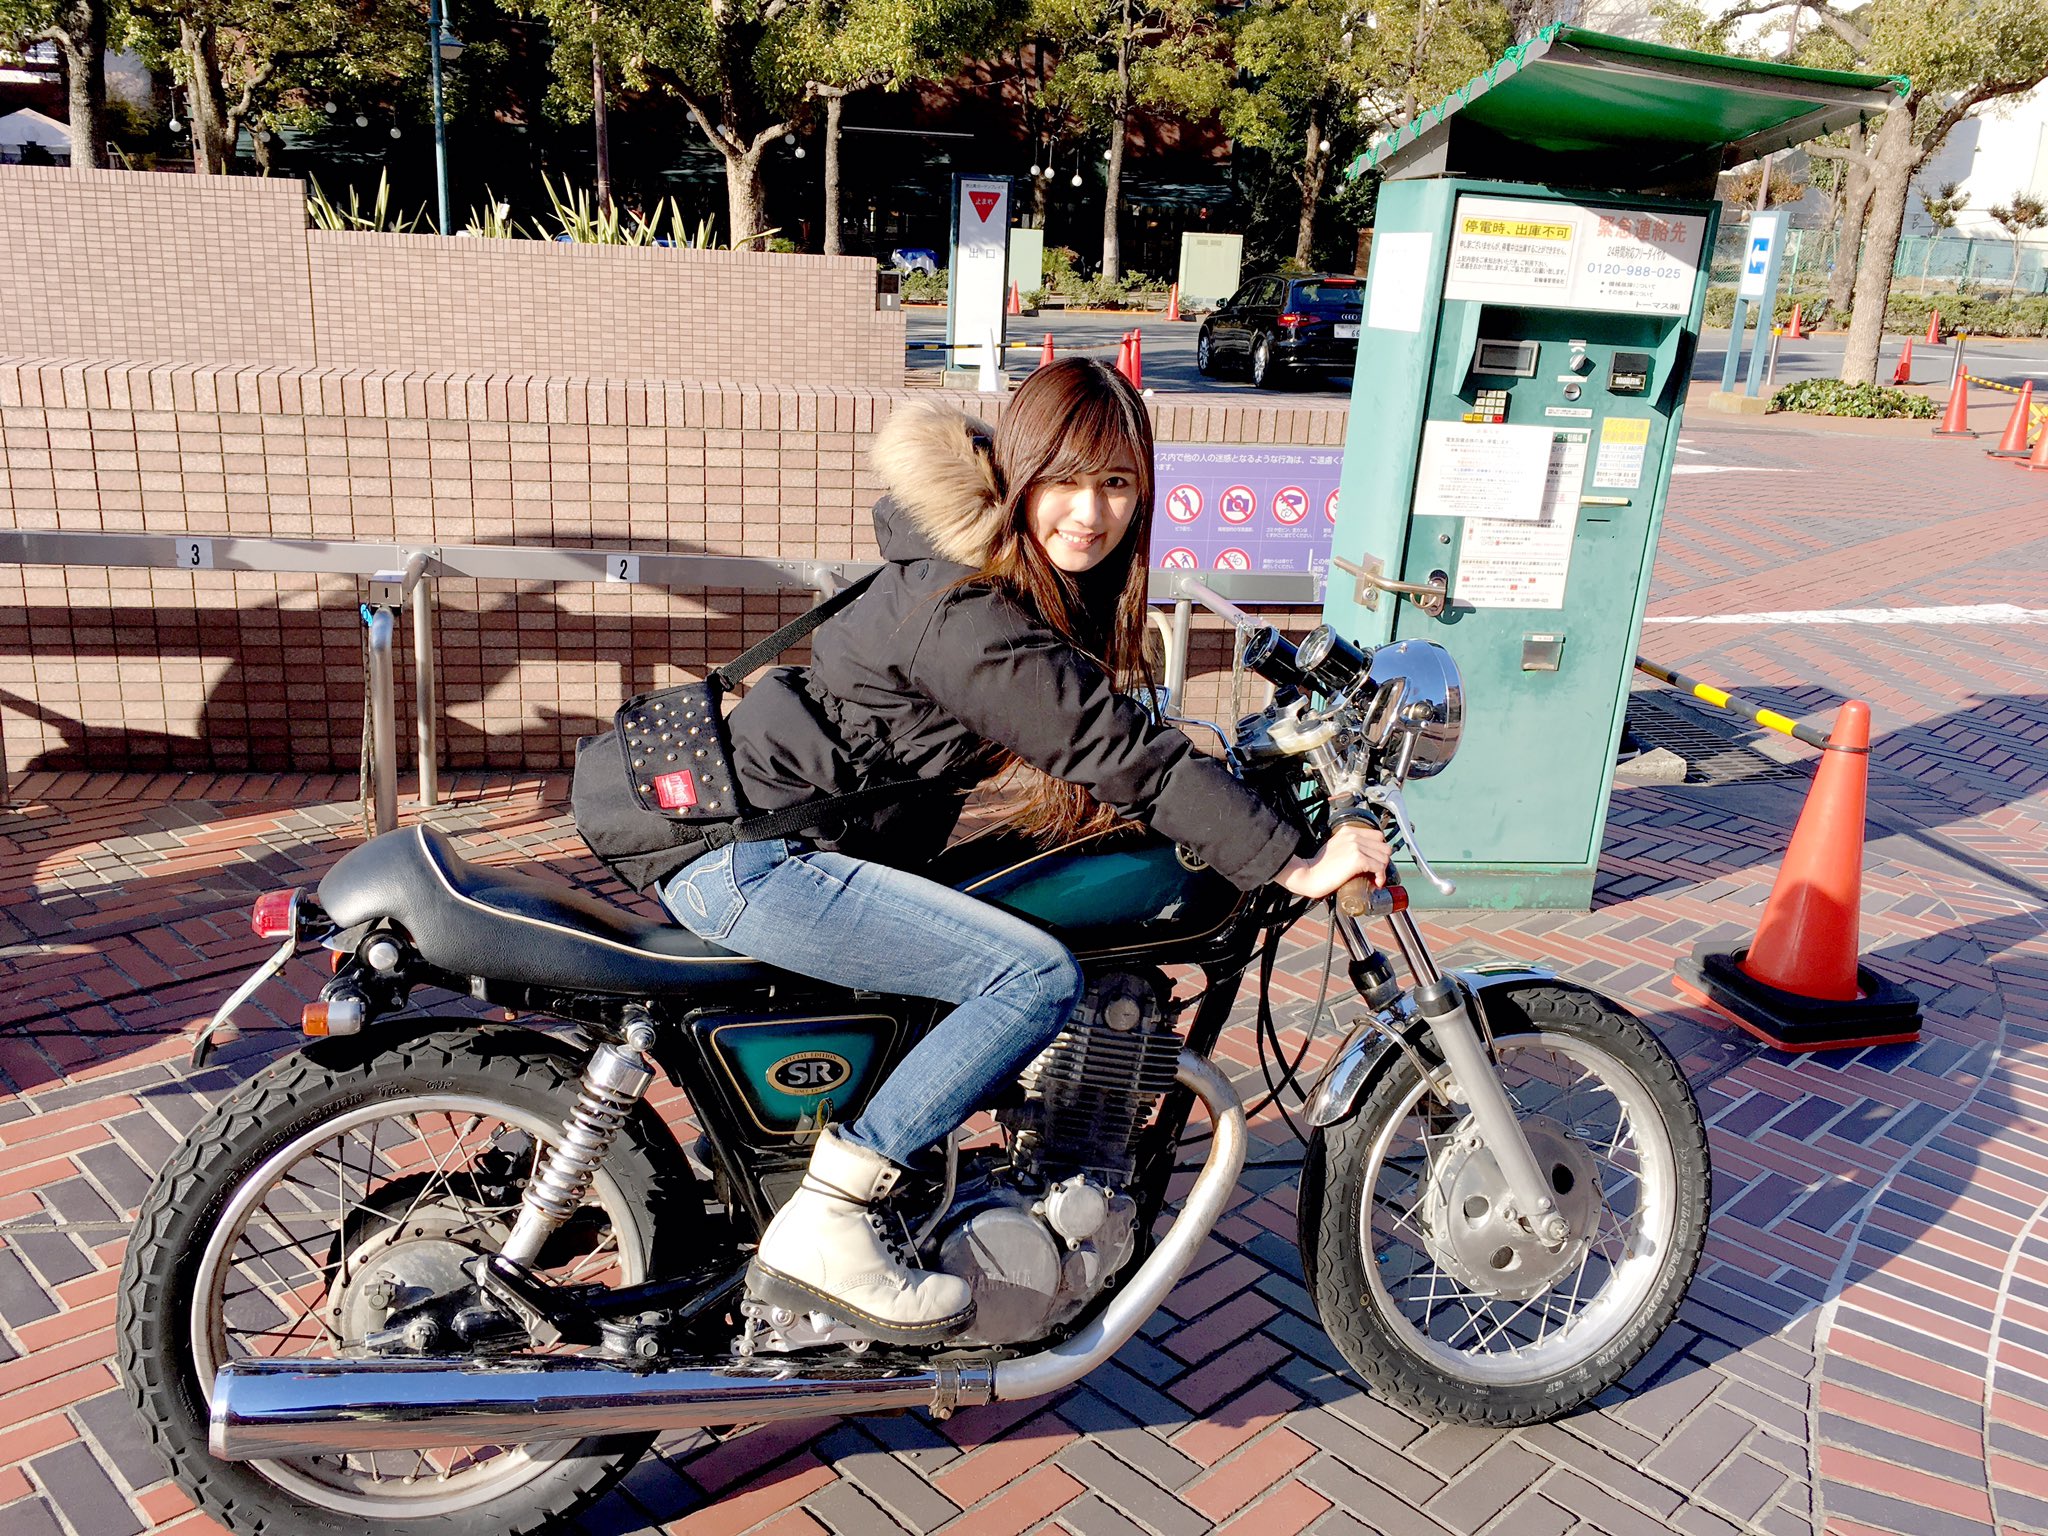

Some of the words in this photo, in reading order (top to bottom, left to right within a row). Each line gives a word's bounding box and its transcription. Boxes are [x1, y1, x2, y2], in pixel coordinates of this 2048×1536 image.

[975, 197, 994, 205] 止まれ
[1465, 219, 1570, 239] 停電時、出庫不可
[1597, 215, 1688, 244] 緊急連絡先
[1587, 262, 1681, 279] 0120-988-025
[190, 545, 200, 565] 3
[619, 559, 628, 580] 2
[781, 1053, 807, 1064] SPECIAL
[810, 1052, 838, 1060] EDITION
[788, 1061, 834, 1085] SR
[240, 1091, 365, 1178] ROADMASTER
[1678, 1165, 1693, 1250] DUNLOP
[1596, 1249, 1683, 1368] ROADMASTER
